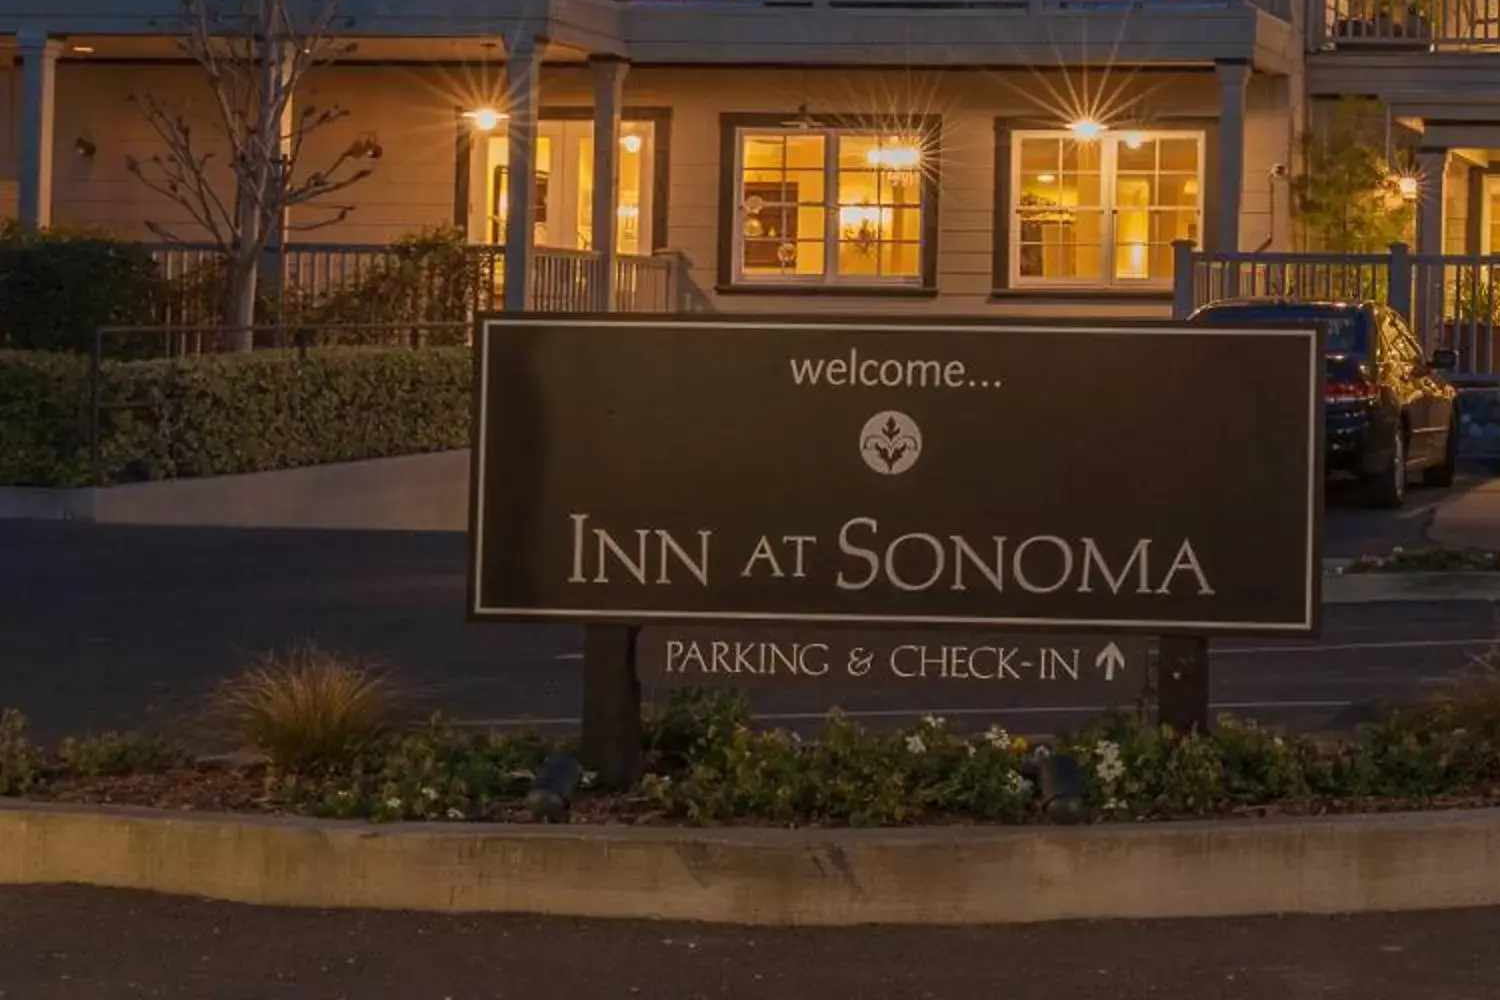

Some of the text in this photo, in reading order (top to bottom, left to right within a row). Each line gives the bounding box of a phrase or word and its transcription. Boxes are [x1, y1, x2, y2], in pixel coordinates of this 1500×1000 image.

[789, 347, 1002, 389] welcome...
[741, 534, 818, 578] AT
[665, 640, 1081, 681] PARKING & CHECK-IN
